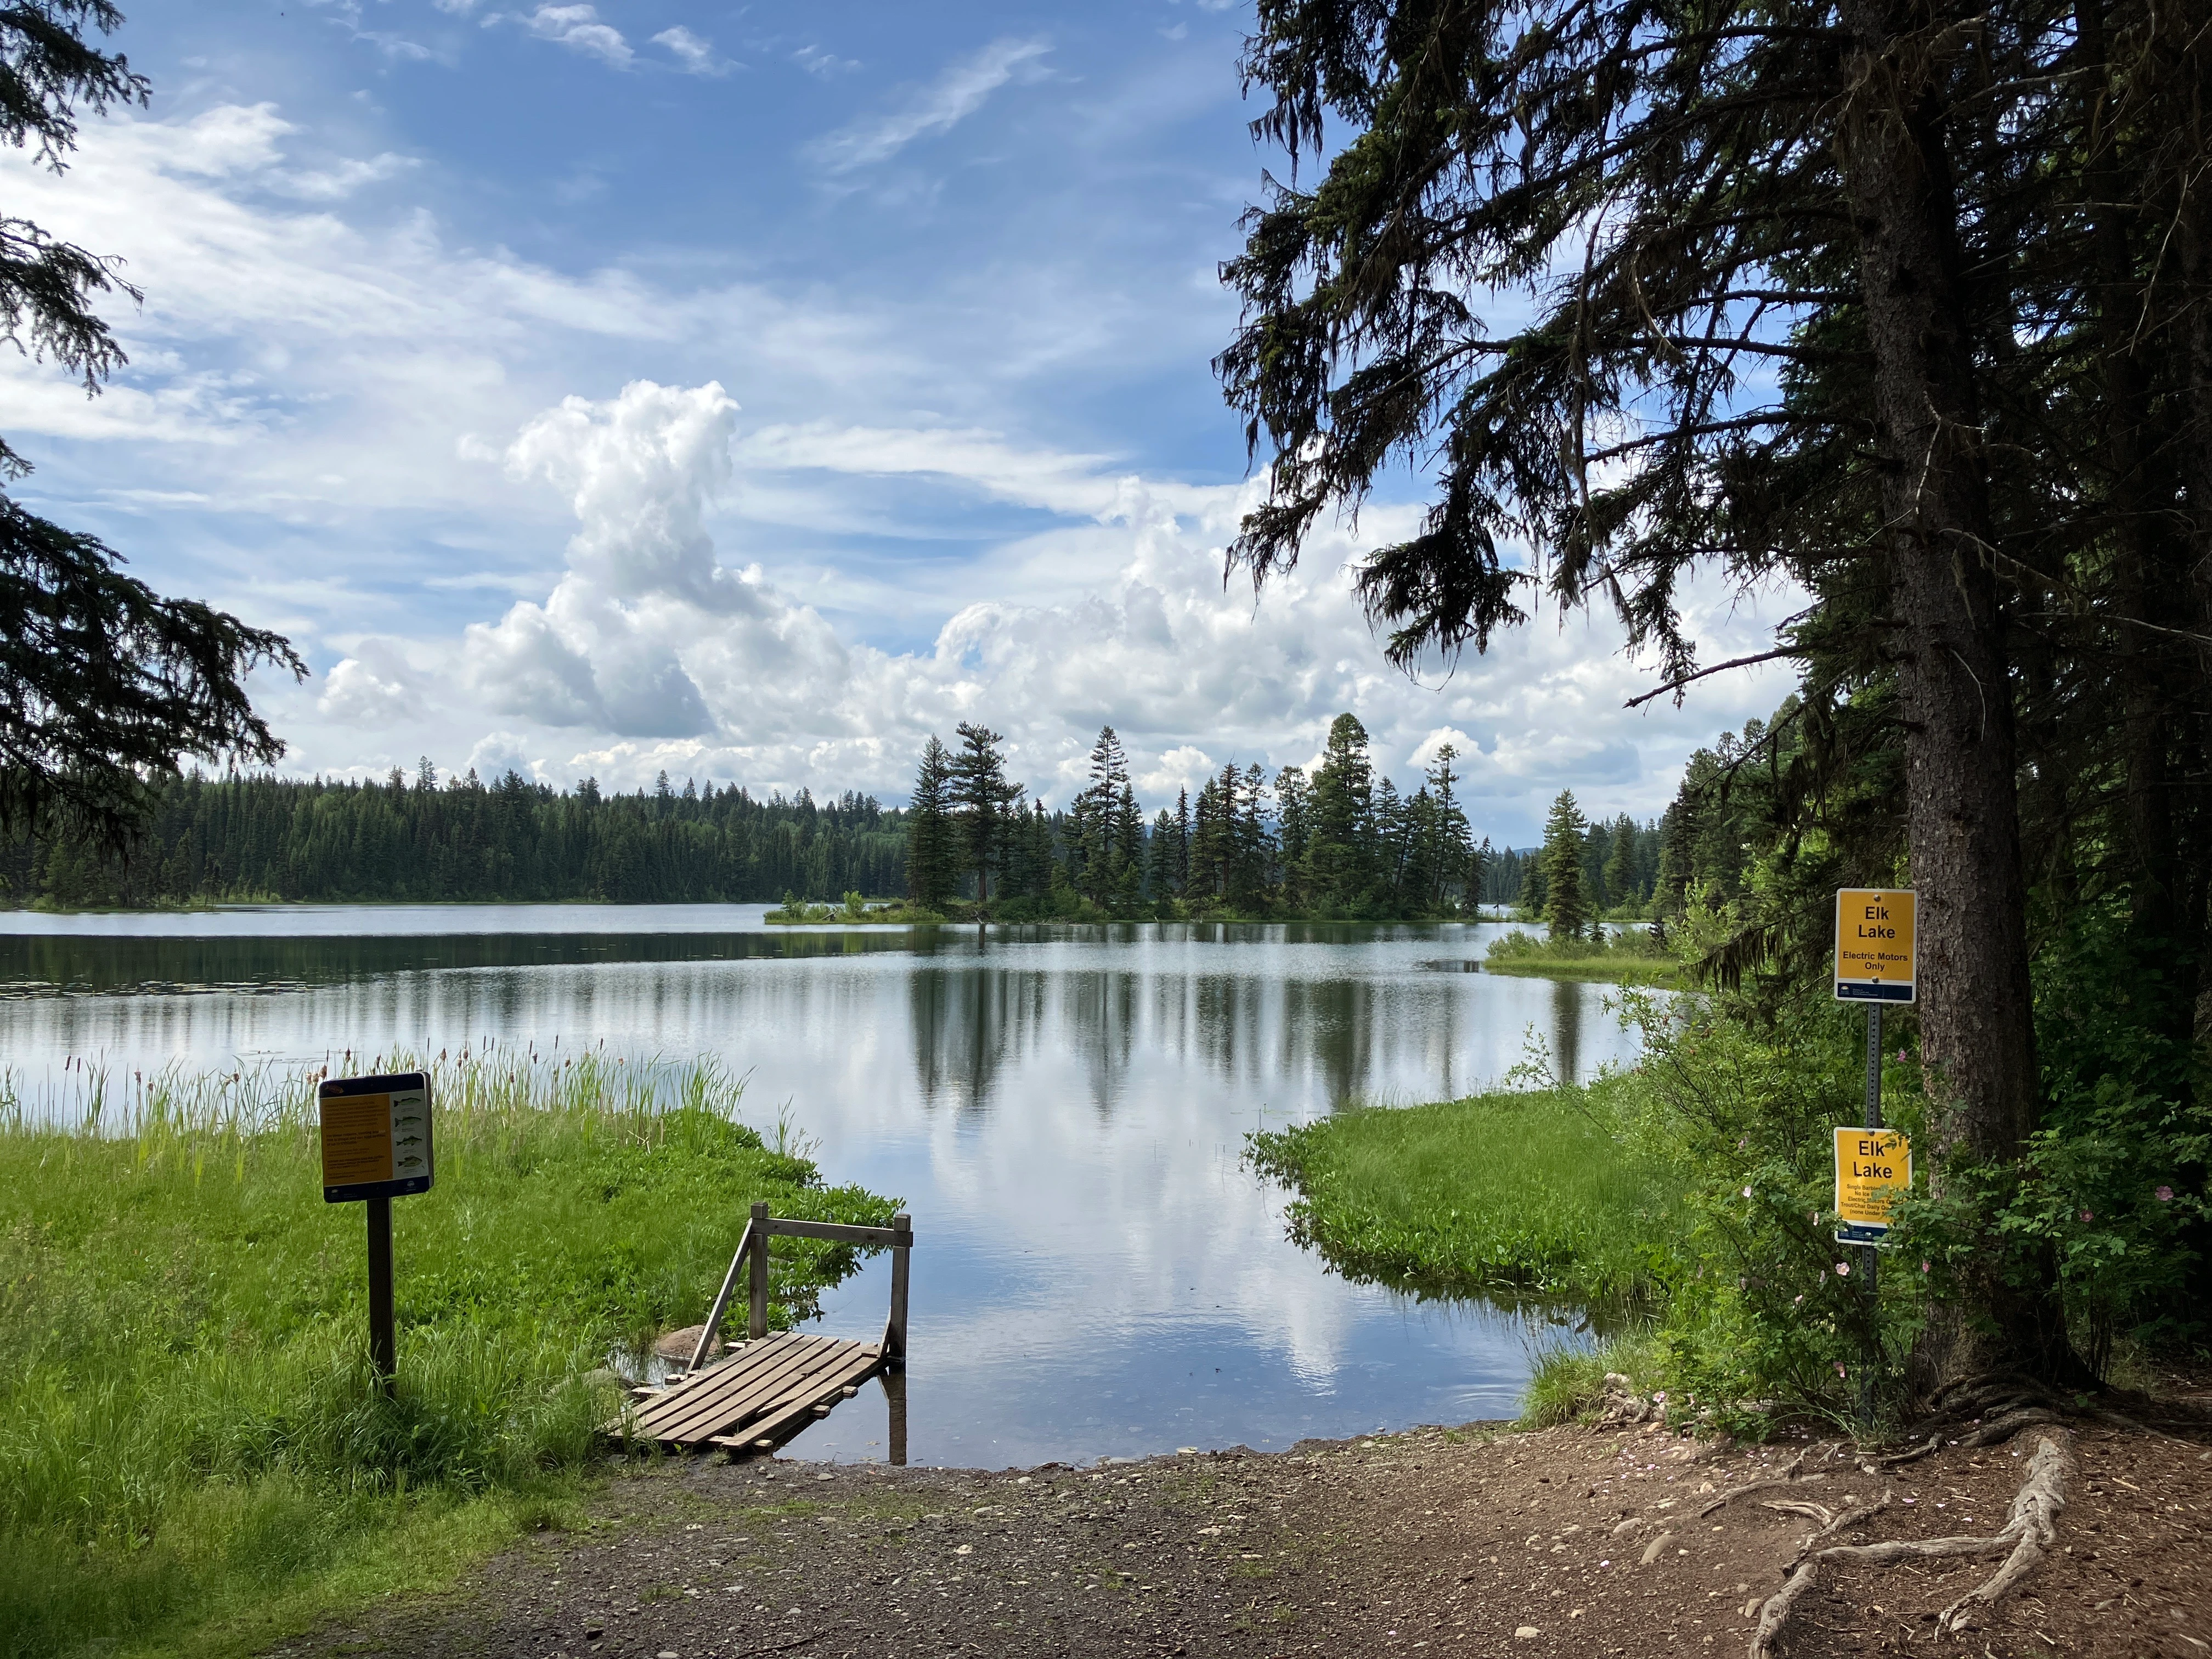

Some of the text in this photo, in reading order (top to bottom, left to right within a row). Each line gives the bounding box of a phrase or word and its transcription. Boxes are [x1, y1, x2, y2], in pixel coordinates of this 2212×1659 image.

[1865, 906, 1889, 920] Elk
[1858, 924, 1895, 939] Lake
[1843, 951, 1908, 961] Electric Motors
[1865, 962, 1885, 972] Only
[1859, 1141, 1886, 1157] Elk
[1853, 1161, 1892, 1178] Lake
